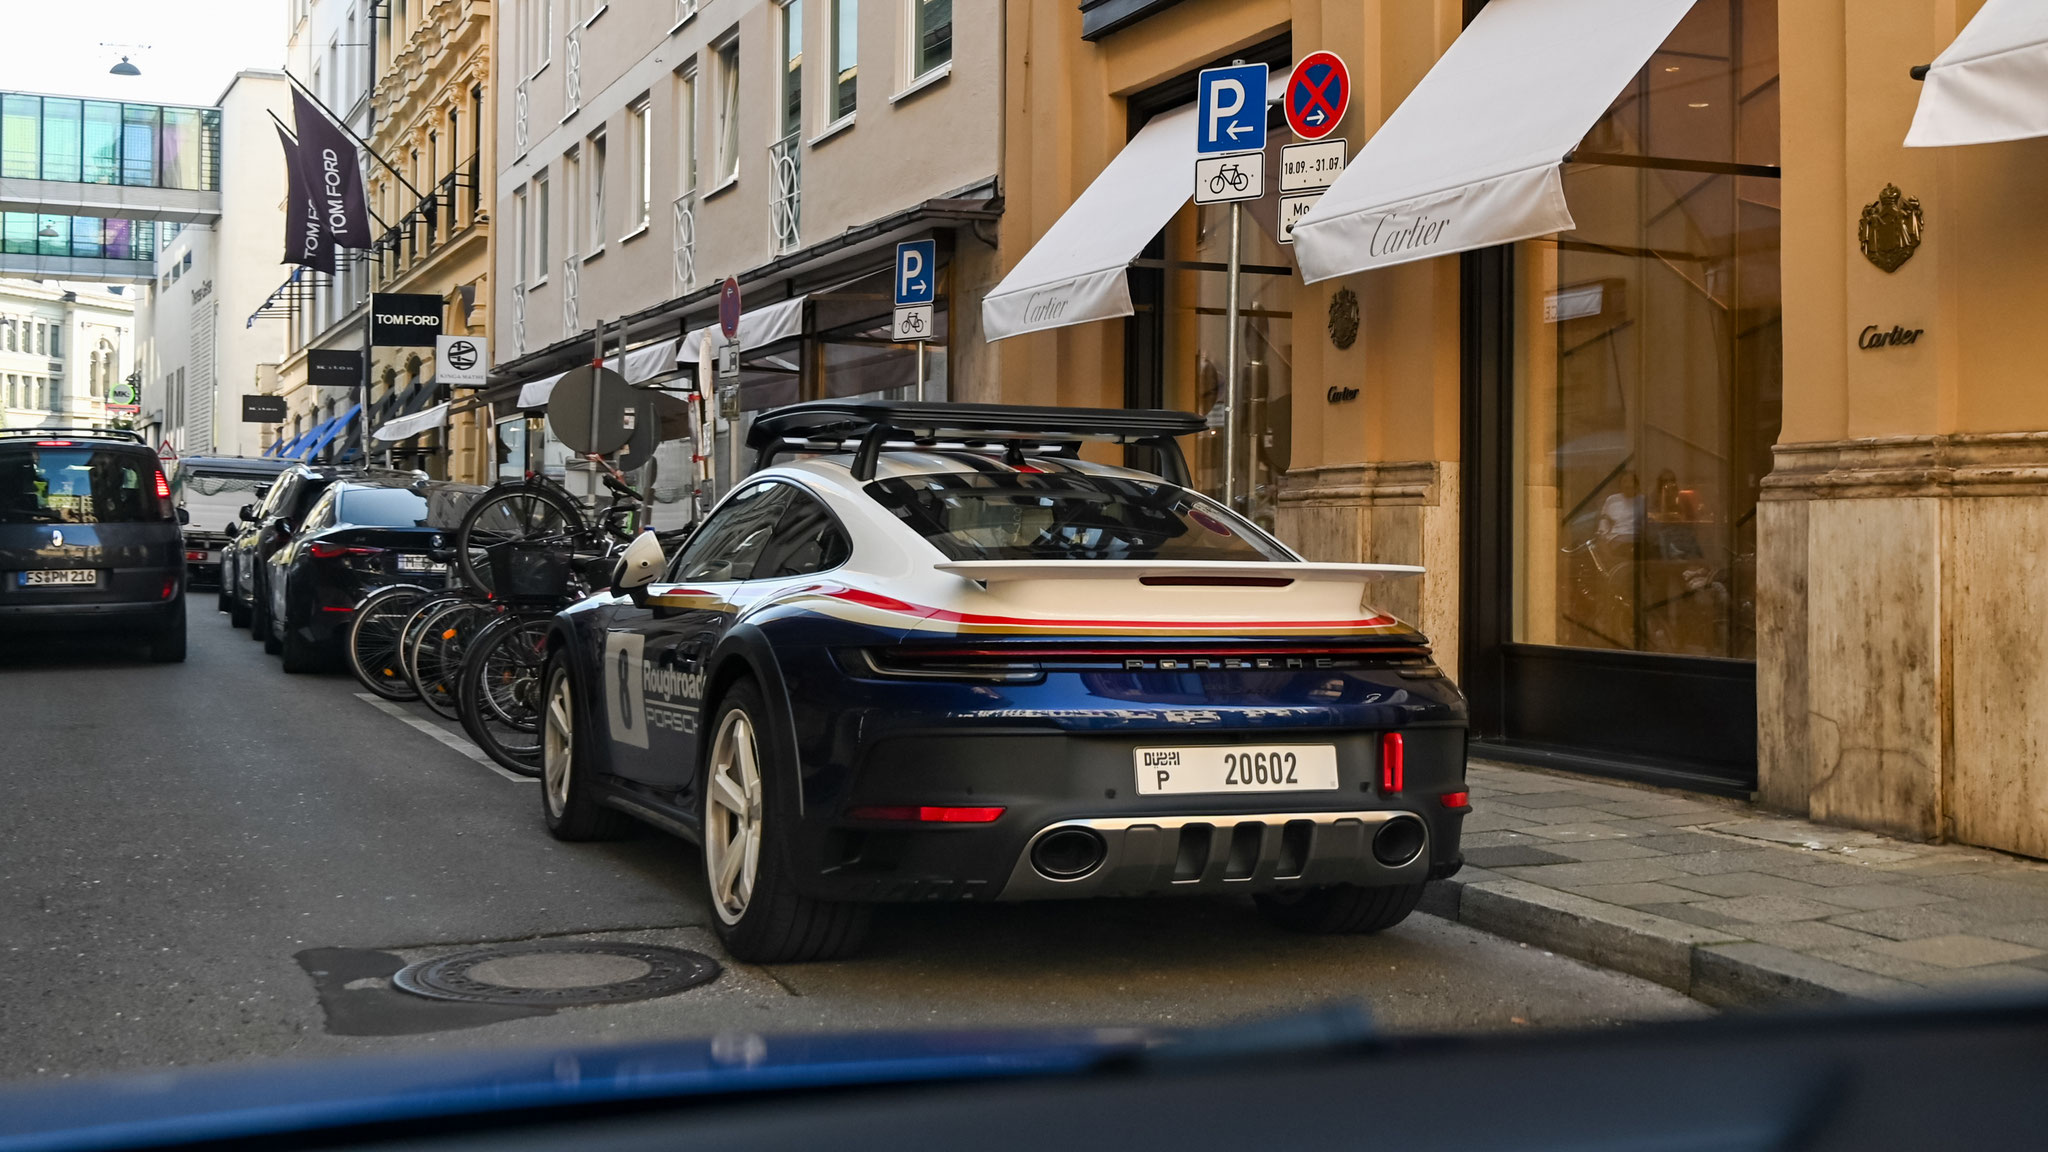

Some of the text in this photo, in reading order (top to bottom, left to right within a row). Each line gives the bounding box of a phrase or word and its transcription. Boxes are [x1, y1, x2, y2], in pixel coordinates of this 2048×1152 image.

[1208, 78, 1246, 143] P
[322, 148, 348, 236] TOM FORD
[303, 222, 321, 260] TOM
[1369, 212, 1451, 257] Cartier
[901, 249, 923, 297] P
[376, 313, 440, 326] TOM FORD
[1023, 291, 1069, 325] Cartier
[1858, 324, 1925, 351] Cartier
[1327, 385, 1360, 404] Cartier
[26, 570, 94, 584] FS PM 216
[1125, 658, 1332, 670] PORSCHE
[617, 647, 633, 730] 8
[1156, 769, 1171, 791] P
[1224, 752, 1298, 785] 20602
